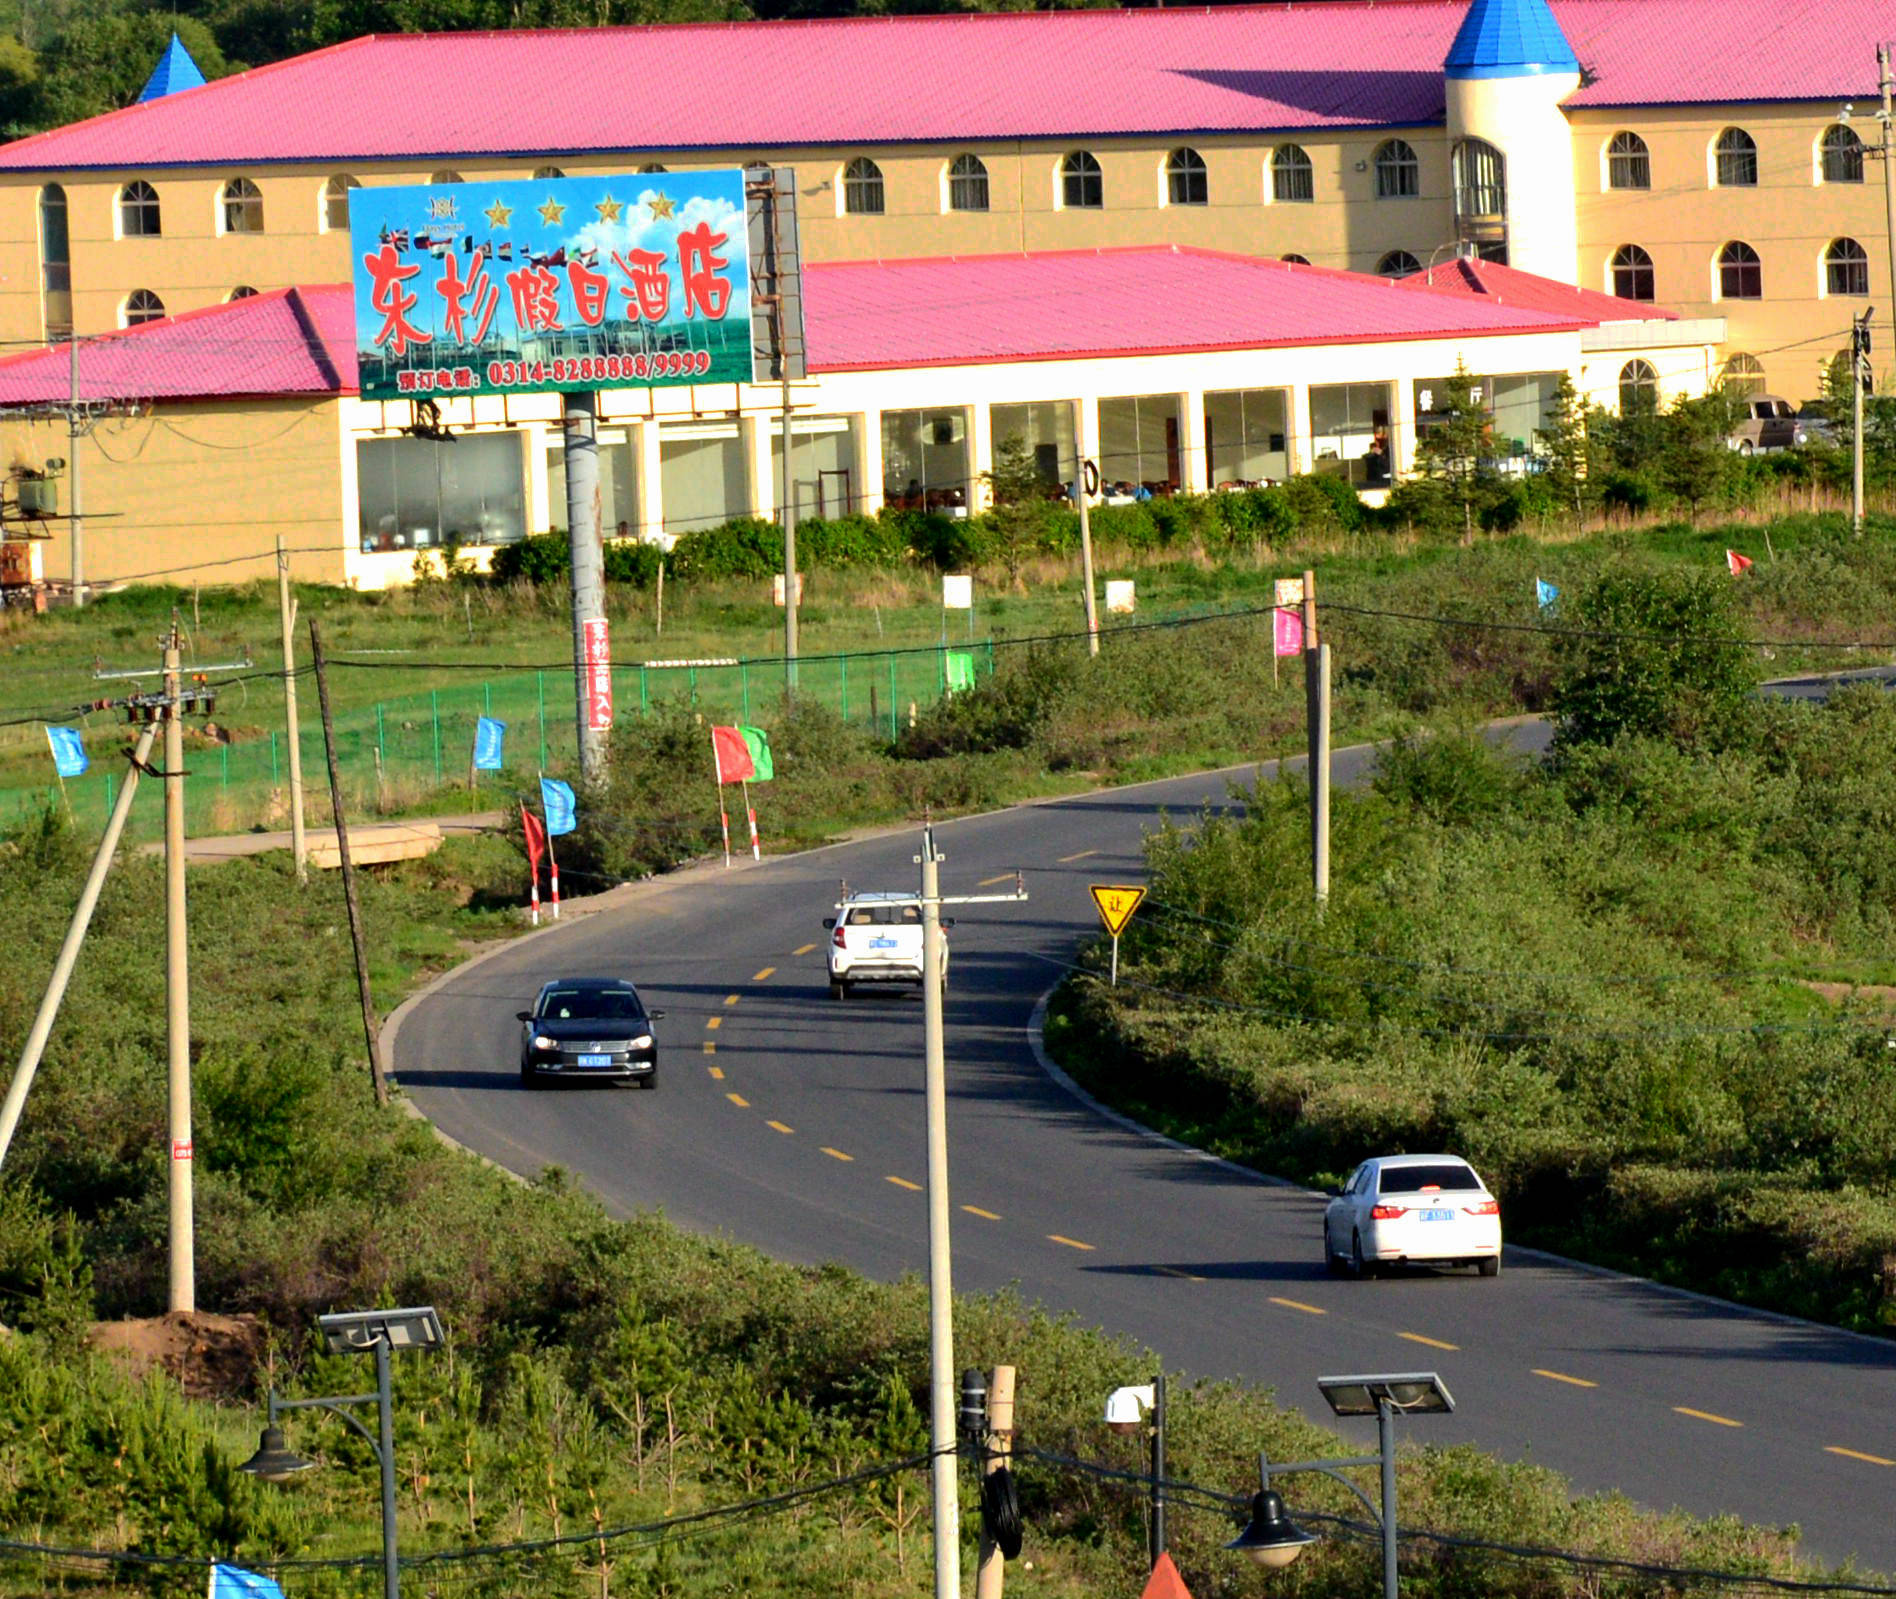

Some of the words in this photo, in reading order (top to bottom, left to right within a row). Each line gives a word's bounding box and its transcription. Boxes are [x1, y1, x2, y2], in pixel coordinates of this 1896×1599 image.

[364, 221, 733, 355] 东杉假日酒店
[1109, 895, 1125, 914] 让
